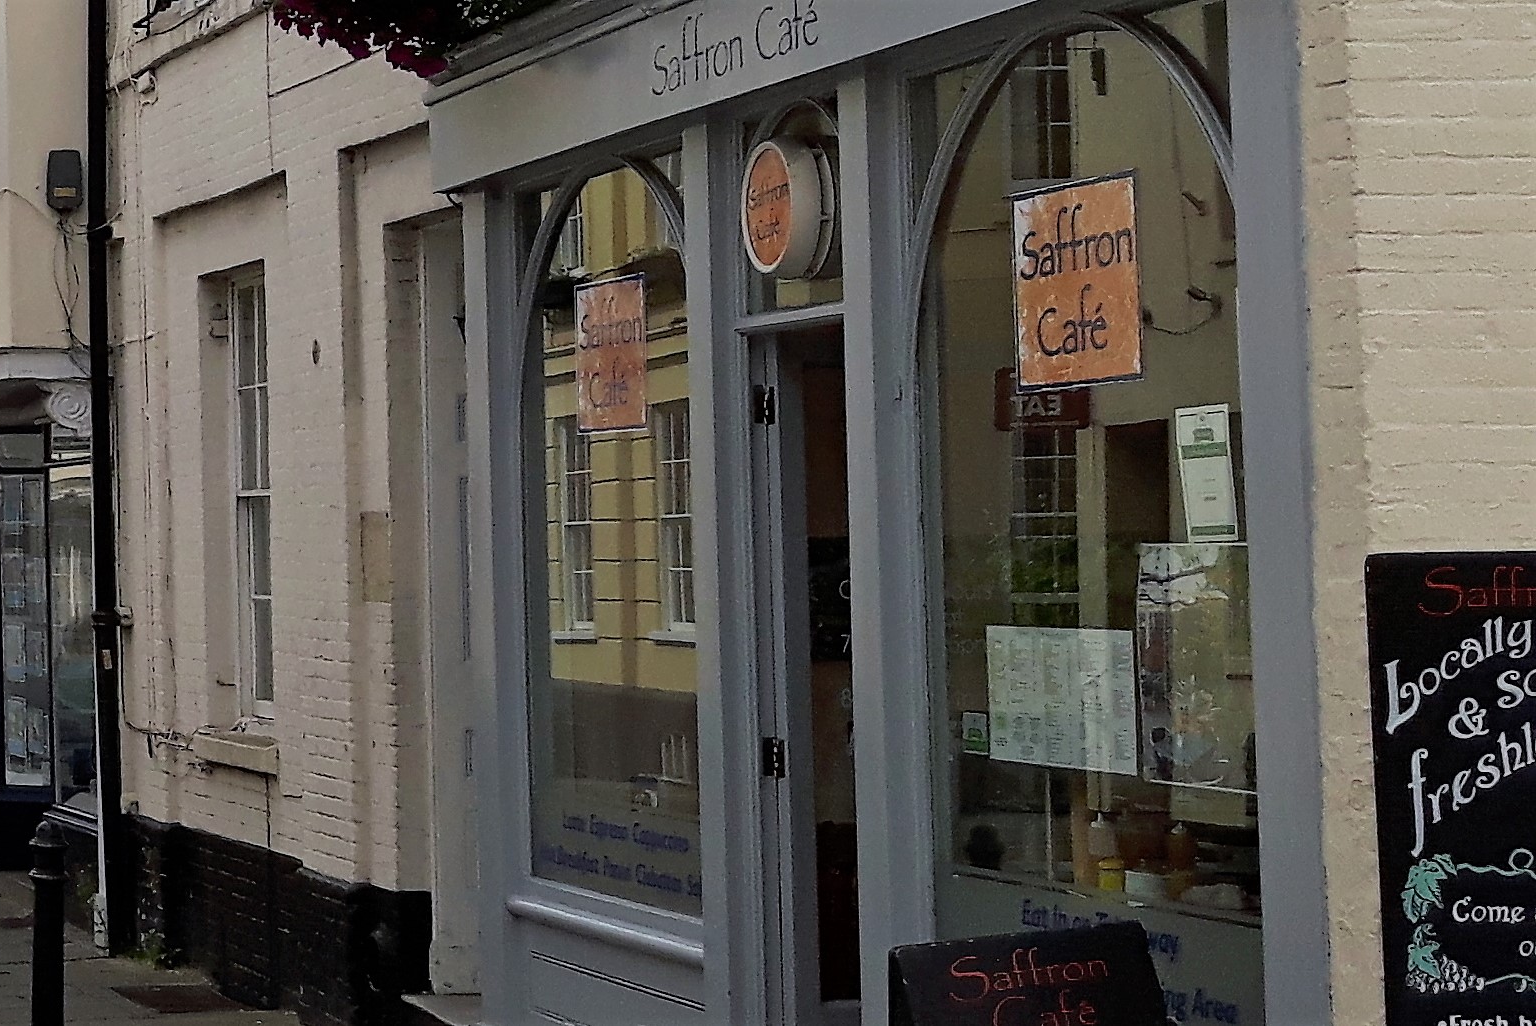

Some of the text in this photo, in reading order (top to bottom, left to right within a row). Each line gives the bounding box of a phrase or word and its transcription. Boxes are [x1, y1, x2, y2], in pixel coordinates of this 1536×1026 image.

[652, 0, 819, 95] Saffron Café
[1020, 203, 1134, 281] Saffron
[579, 296, 643, 350] Saffron
[1037, 283, 1109, 357] Café
[1383, 616, 1533, 736] Locally
[1448, 698, 1489, 738] &
[1452, 896, 1526, 924] Come
[949, 947, 1108, 1001] Saffron
